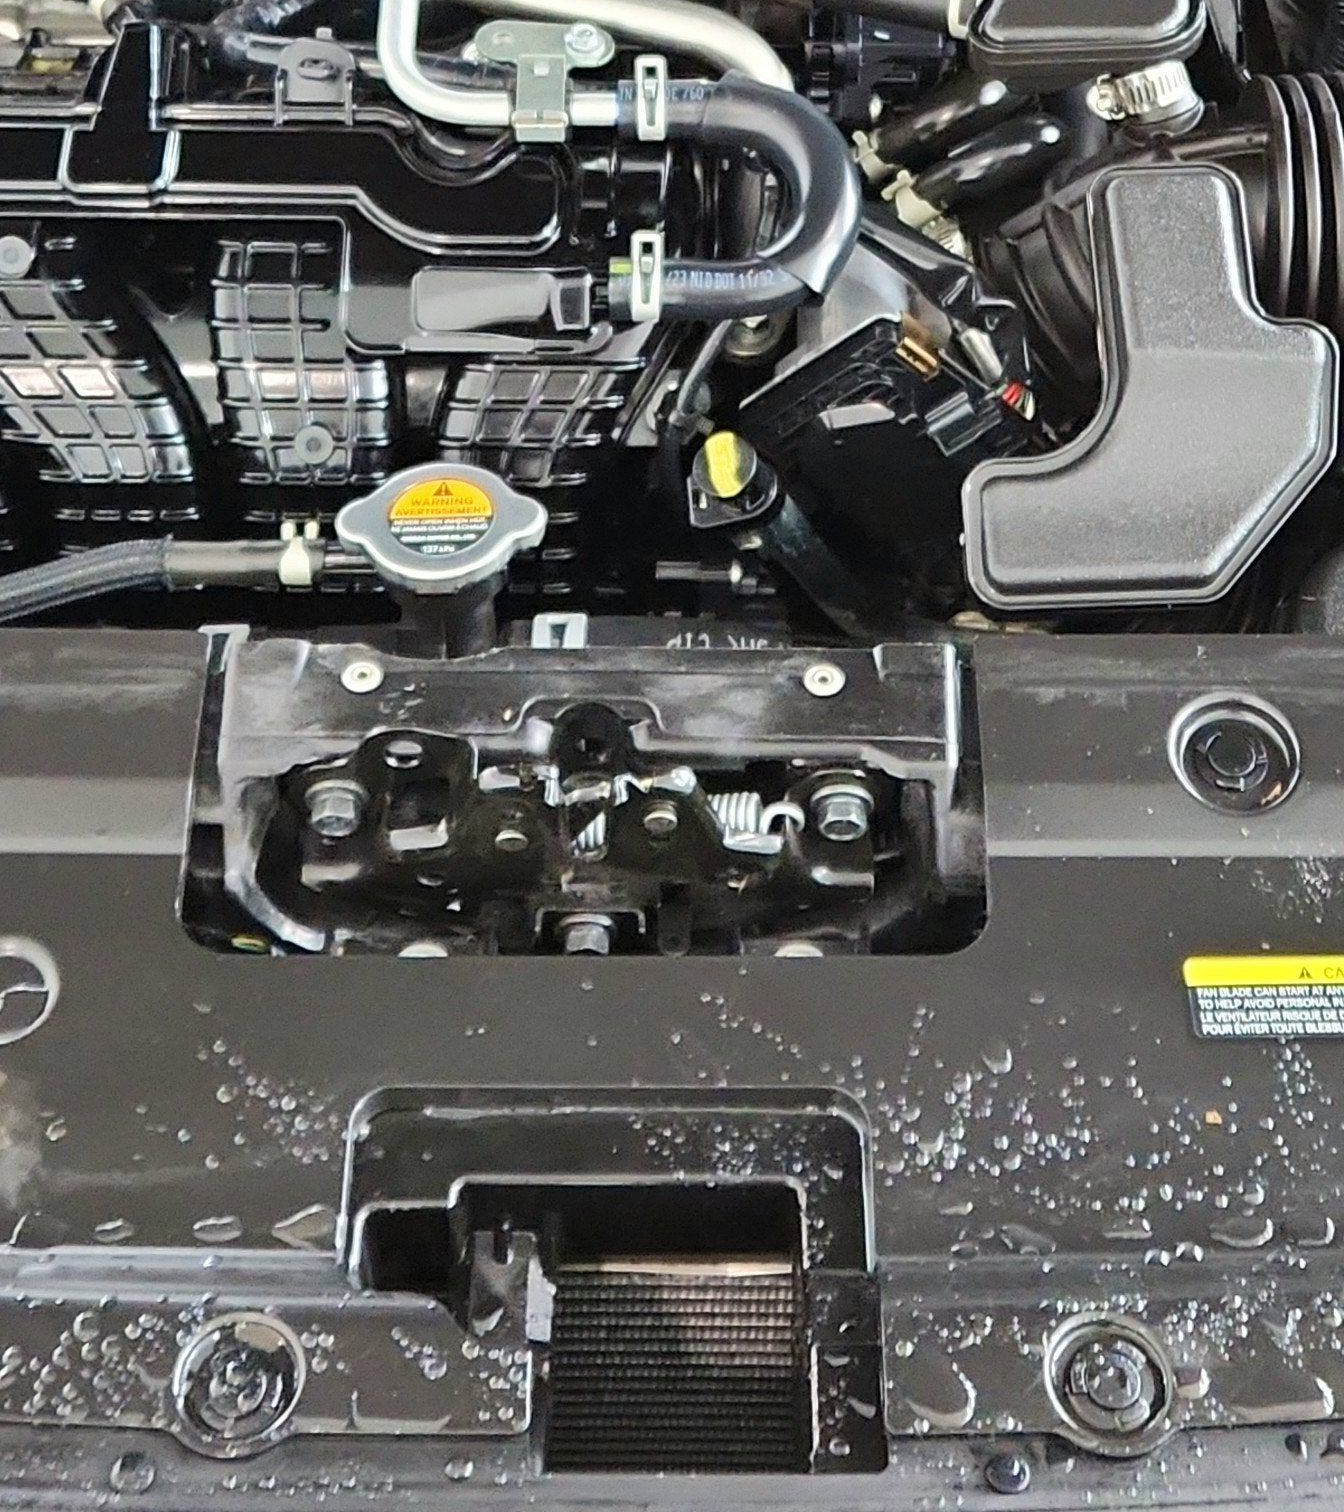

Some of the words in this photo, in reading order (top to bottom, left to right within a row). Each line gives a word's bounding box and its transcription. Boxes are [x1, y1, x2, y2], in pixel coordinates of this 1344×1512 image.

[411, 496, 473, 507] WARNING
[395, 506, 487, 516] AVERTISSEMENT
[1254, 986, 1277, 997] CAN
[1198, 998, 1214, 1010] TO
[1215, 998, 1243, 1009] HELP
[1243, 997, 1275, 1009] AVOID
[1276, 997, 1332, 1009] PERSONAL
[1200, 1010, 1214, 1023] LE
[1215, 1009, 1281, 1023] VENTILATEUR
[1323, 1008, 1339, 1021] DE
[1202, 1023, 1233, 1035] POUR
